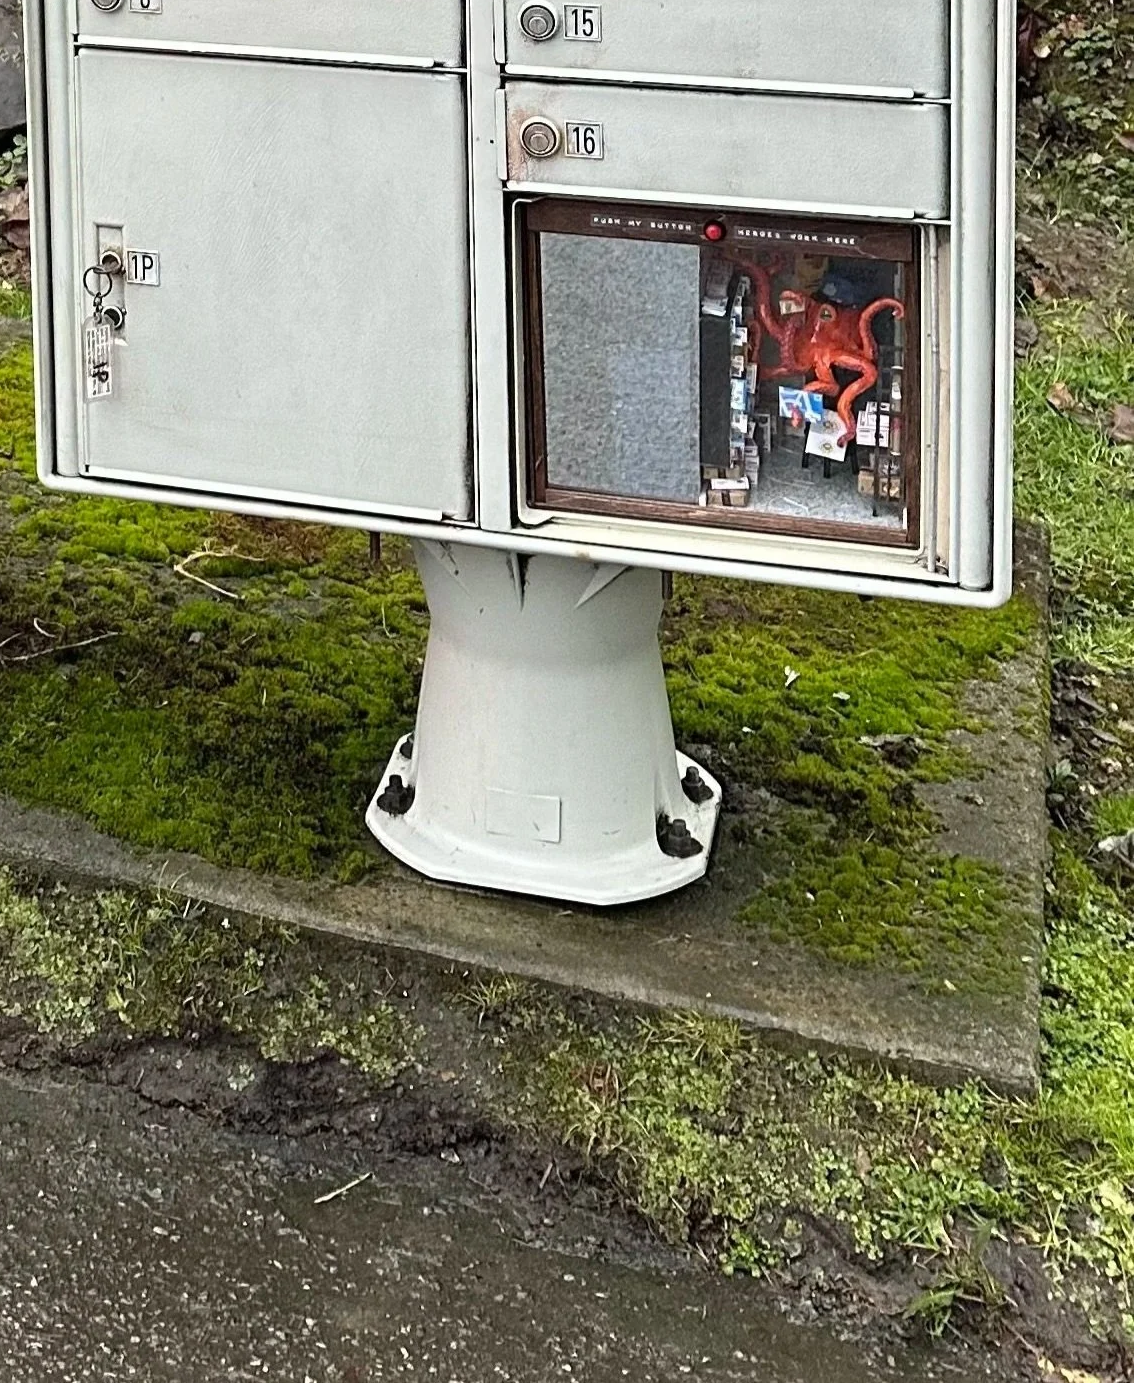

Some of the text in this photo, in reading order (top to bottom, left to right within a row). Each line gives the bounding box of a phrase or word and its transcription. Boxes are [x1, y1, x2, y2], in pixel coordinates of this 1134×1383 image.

[572, 9, 594, 36] 15
[572, 127, 595, 154] 16
[594, 217, 621, 226] PUSH
[651, 221, 692, 231] BUTTON
[738, 229, 855, 245] HEROES WORK HERE
[132, 255, 153, 280] 1P
